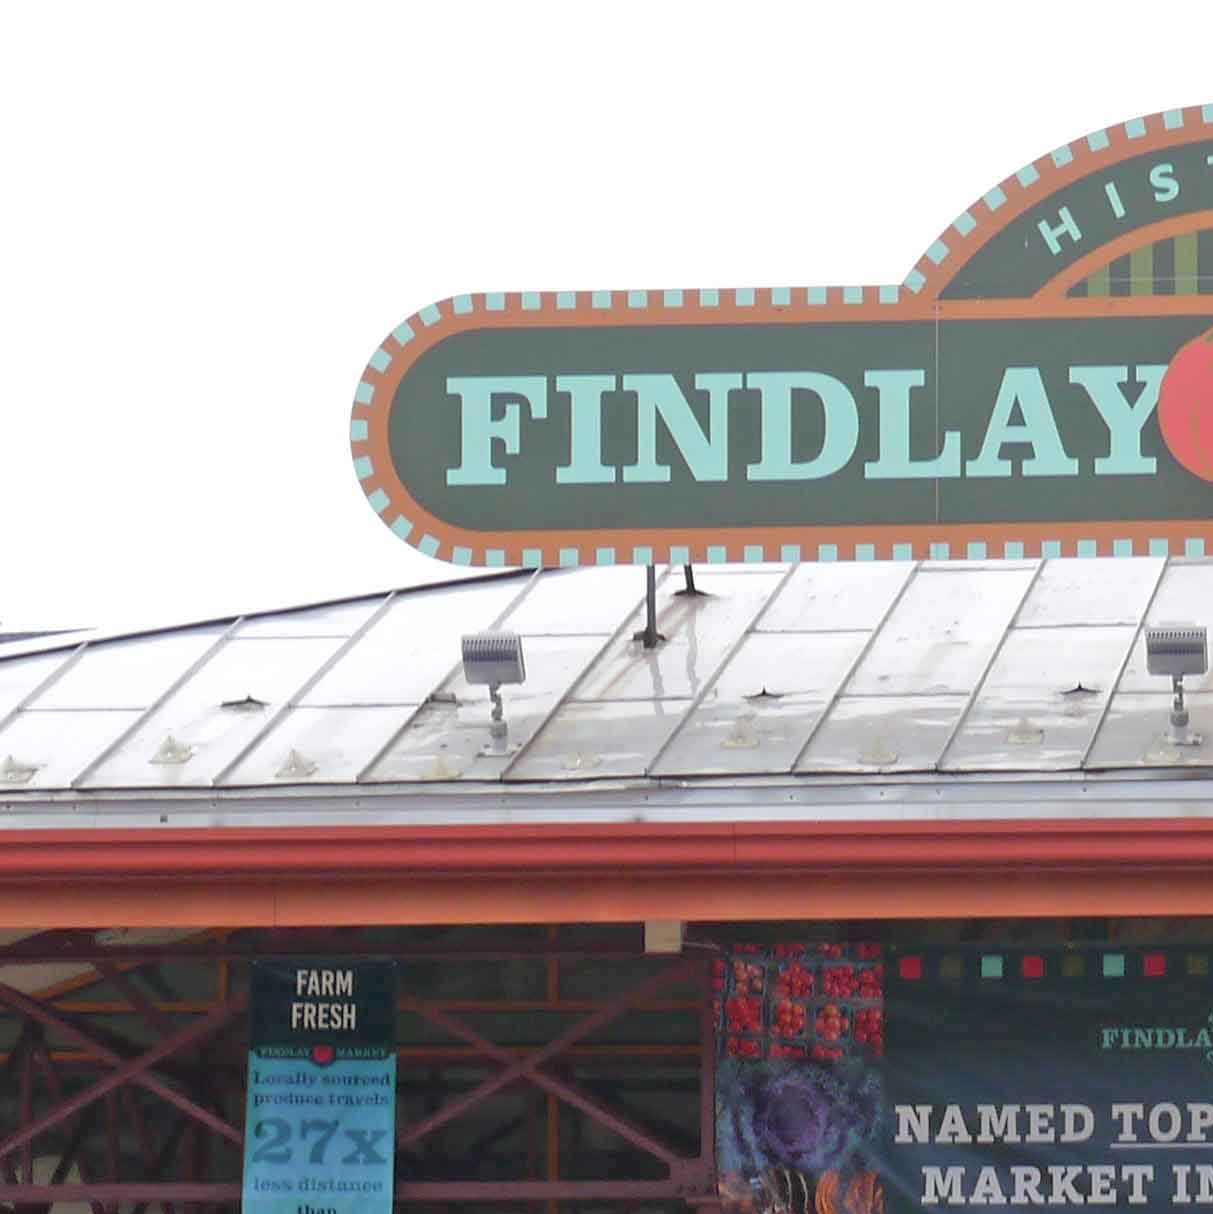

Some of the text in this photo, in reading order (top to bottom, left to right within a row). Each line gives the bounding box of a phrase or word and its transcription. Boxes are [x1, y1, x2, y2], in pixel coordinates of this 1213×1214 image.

[446, 365, 1166, 486] FINDLAY
[296, 969, 353, 996] FARM
[291, 1002, 357, 1030] FRESH
[253, 1072, 391, 1088] Locally sourced
[254, 1092, 389, 1107] produce travels
[895, 1104, 1095, 1143] NAMED
[254, 1176, 383, 1193] less distance
[921, 1165, 1154, 1204] MARKET
